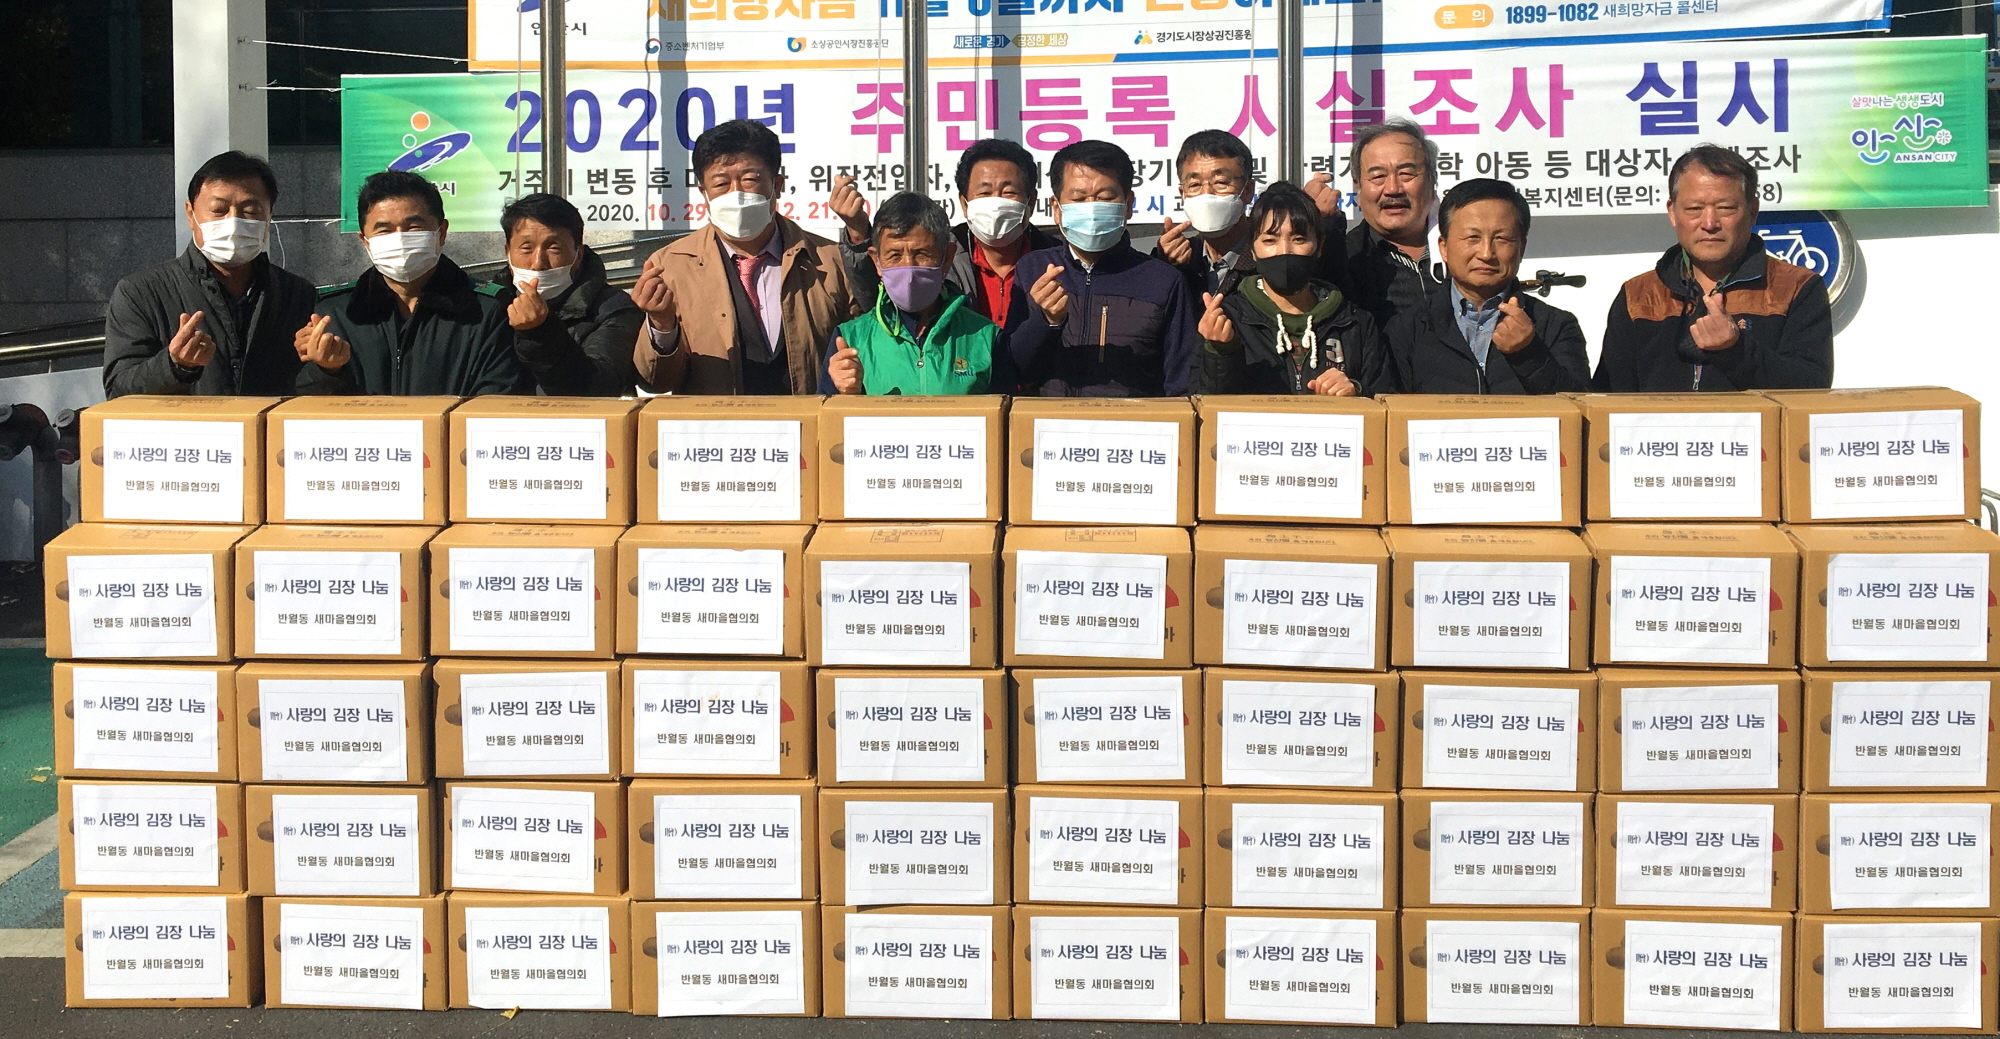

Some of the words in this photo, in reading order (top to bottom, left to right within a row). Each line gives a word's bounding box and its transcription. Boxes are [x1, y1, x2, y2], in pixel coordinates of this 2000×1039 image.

[1505, 3, 1600, 24] 1899-1082
[1603, 1, 1673, 18] 새희망자금
[1676, 0, 1719, 14] 콜센터
[810, 38, 890, 50] 소상공인시장진흥공단
[954, 36, 983, 49] 새로운
[986, 35, 1006, 48] 경기
[1016, 34, 1046, 47] 공정한
[1048, 33, 1069, 46] 세상
[1156, 29, 1252, 43] 경기도시장상권진흥원
[665, 39, 725, 52] 중소벤처기업부
[504, 83, 796, 155] 2020년
[850, 75, 1176, 154] 주민등록
[1625, 58, 1790, 136] 실시
[1852, 96, 1893, 108] 살맛나는
[1896, 93, 1943, 109] 생생도시
[1895, 153, 1932, 162] ANSAN
[1934, 152, 1956, 161] CITY
[587, 168, 637, 195] 변동
[647, 167, 673, 195] 후
[1475, 151, 1533, 180] 아동
[1544, 150, 1573, 179] 등
[1586, 147, 1672, 178] 대상자
[587, 204, 640, 222] 2020.
[648, 203, 676, 222] 10.
[1146, 194, 1165, 216] 시
[128, 447, 168, 463] 사랑의
[174, 448, 201, 464] 김장
[206, 449, 233, 464] 나눔
[491, 445, 530, 461] 사랑의
[536, 445, 564, 462] 김장
[569, 446, 595, 461] 나눔
[869, 444, 909, 460] 사랑의
[915, 444, 943, 460] 김장
[948, 444, 975, 460] 나눔
[1243, 440, 1284, 457] 사랑의
[1290, 441, 1319, 458] 김장
[1324, 442, 1352, 459] 나눔
[1636, 441, 1679, 458] 사랑의
[1685, 441, 1715, 458] 김장
[1721, 441, 1749, 457] 나눔
[125, 480, 155, 492] 반월동
[160, 481, 220, 493] 새마을협의회
[488, 478, 518, 490] 반월동
[523, 479, 583, 491] 새마을협의회
[866, 478, 897, 490] 반월동
[901, 478, 963, 490] 새마을협의회
[1239, 474, 1270, 487] 반월동
[1275, 475, 1338, 489] 새마을협의회
[1633, 476, 1666, 488] 반월동
[1671, 476, 1736, 488] 새마을협의회
[280, 579, 322, 595] 사랑의
[328, 579, 356, 596] 김장
[362, 579, 389, 595] 나눔
[664, 577, 705, 593] 사랑의
[711, 577, 740, 594] 김장
[745, 578, 773, 594] 나눔
[1855, 582, 1901, 599] 사랑의
[1908, 582, 1939, 599] 김장
[1945, 582, 1976, 599] 나눔
[1441, 590, 1485, 607] 사랑의
[1491, 590, 1522, 607] 김장
[1527, 590, 1557, 607] 나눔
[277, 613, 309, 625] 반월동
[313, 613, 377, 625] 새마을협의회
[660, 611, 692, 624] 반월동
[696, 612, 759, 624] 새마을협의회
[1851, 618, 1886, 631] 반월동
[1891, 618, 1961, 631] 새마을협의회
[1438, 624, 1471, 637] 반월동
[1476, 625, 1543, 638] 새마을협의회
[99, 695, 139, 712] 사랑의
[146, 697, 174, 713] 김장
[179, 698, 206, 714] 나눔
[861, 706, 904, 722] 사랑의
[910, 706, 939, 722] 김장
[944, 706, 972, 722] 나눔
[1249, 709, 1292, 726] 사랑의
[1298, 710, 1328, 727] 김장
[1333, 711, 1362, 728] 나눔
[1649, 714, 1693, 731] 사랑의
[1699, 714, 1730, 730] 김장
[1736, 713, 1766, 729] 나눔
[96, 729, 127, 741] 반월동
[132, 730, 194, 743] 새마을협의회
[859, 740, 891, 752] 반월동
[895, 740, 960, 752] 새마을협의회
[1245, 743, 1278, 756] 반월동
[1283, 744, 1348, 758] 새마을협의회
[1646, 749, 1680, 762] 반월동
[1684, 748, 1752, 761] 새마을협의회
[299, 822, 340, 838] 사랑의
[346, 822, 374, 838] 김장
[379, 823, 407, 838] 나눔
[680, 823, 722, 839] 사랑의
[728, 823, 757, 839] 김장
[762, 823, 790, 839] 나눔
[1056, 825, 1098, 843] 사랑의
[1104, 827, 1133, 844] 김장
[1139, 828, 1167, 845] 나눔
[1858, 831, 1903, 848] 사랑의
[1909, 831, 1941, 848] 김장
[1947, 831, 1977, 847] 나눔
[297, 855, 328, 867] 반월동
[333, 856, 395, 868] 새마을협의회
[677, 857, 709, 869] 반월동
[714, 857, 777, 869] 새마을협의회
[1052, 860, 1085, 873] 반월동
[1089, 861, 1154, 875] 새마을협의회
[1854, 866, 1889, 879] 반월동
[1894, 866, 1963, 878] 새마을협의회
[108, 925, 149, 941] 사랑의
[155, 924, 183, 941] 김장
[189, 924, 216, 940] 나눔
[492, 934, 532, 951] 사랑의
[538, 934, 566, 951] 김장
[571, 934, 599, 950] 나눔
[1252, 945, 1295, 962] 사랑의
[1301, 946, 1330, 963] 김장
[1336, 947, 1364, 964] 나눔
[1652, 949, 1696, 967] 사랑의
[1703, 951, 1734, 968] 김장
[1739, 952, 1769, 970] 나눔
[106, 958, 137, 970] 반월동
[142, 958, 204, 970] 새마을협의회
[490, 968, 521, 980] 반월동
[525, 968, 587, 980] 새마을협의회
[1249, 979, 1281, 992] 반월동
[1286, 980, 1351, 994] 새마을협의회
[1649, 984, 1682, 997] 반월동
[1687, 985, 1754, 1000] 새마을협의회
